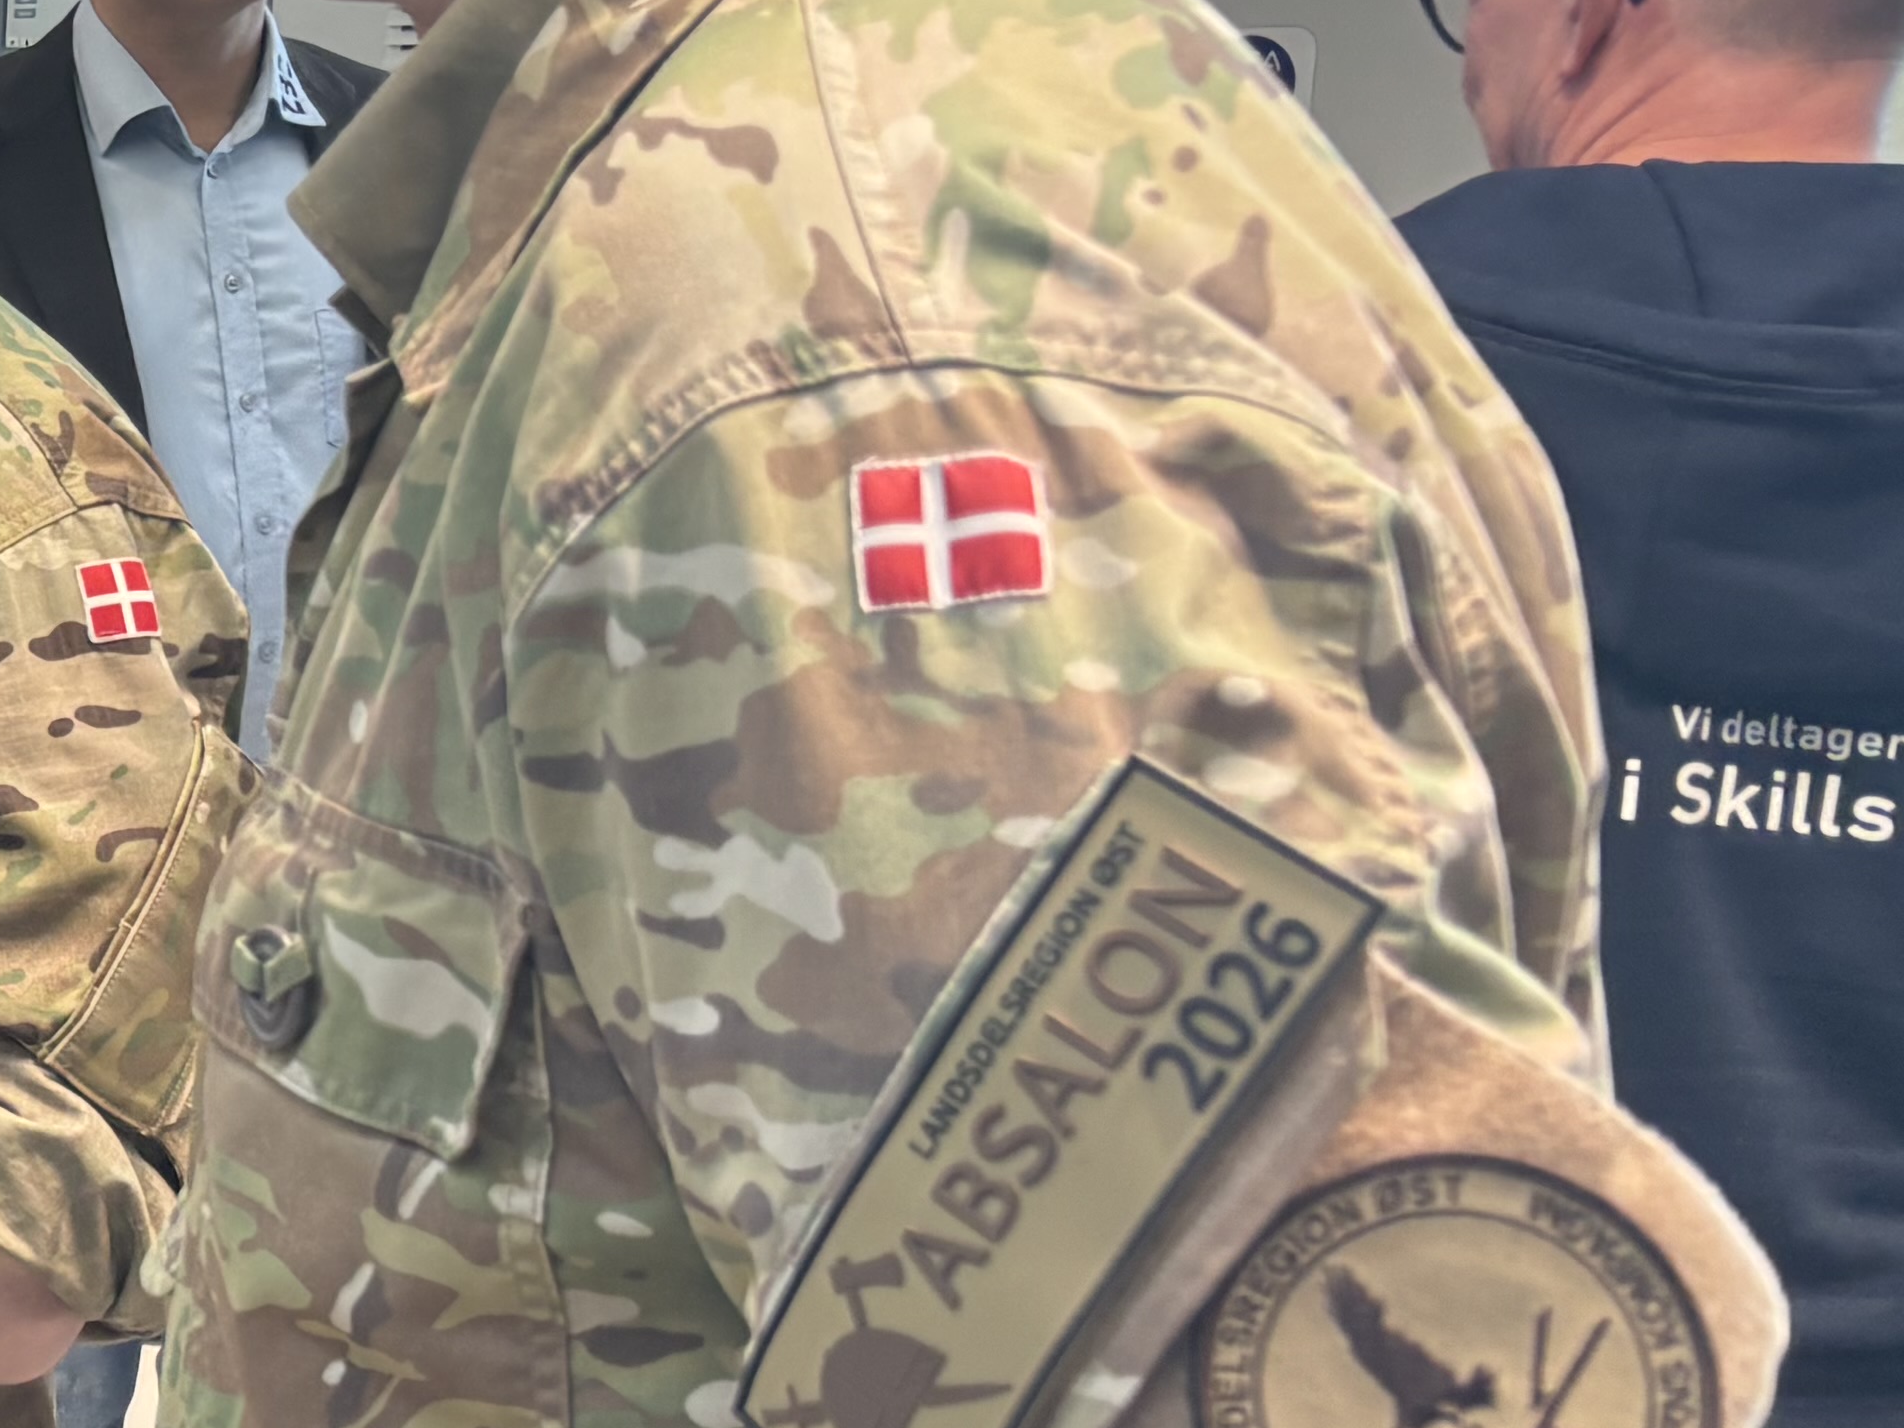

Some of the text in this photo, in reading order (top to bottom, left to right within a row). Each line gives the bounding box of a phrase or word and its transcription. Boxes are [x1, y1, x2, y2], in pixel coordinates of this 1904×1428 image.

[1620, 758, 1897, 843] i Skills
[1671, 704, 1904, 762] Vi deltager
[907, 819, 1145, 1162] LANDSDELSREGION ØST
[1142, 900, 1324, 1113] 2026
[900, 845, 1244, 1313] ABSALON
[1375, 1173, 1465, 1217] ØST
